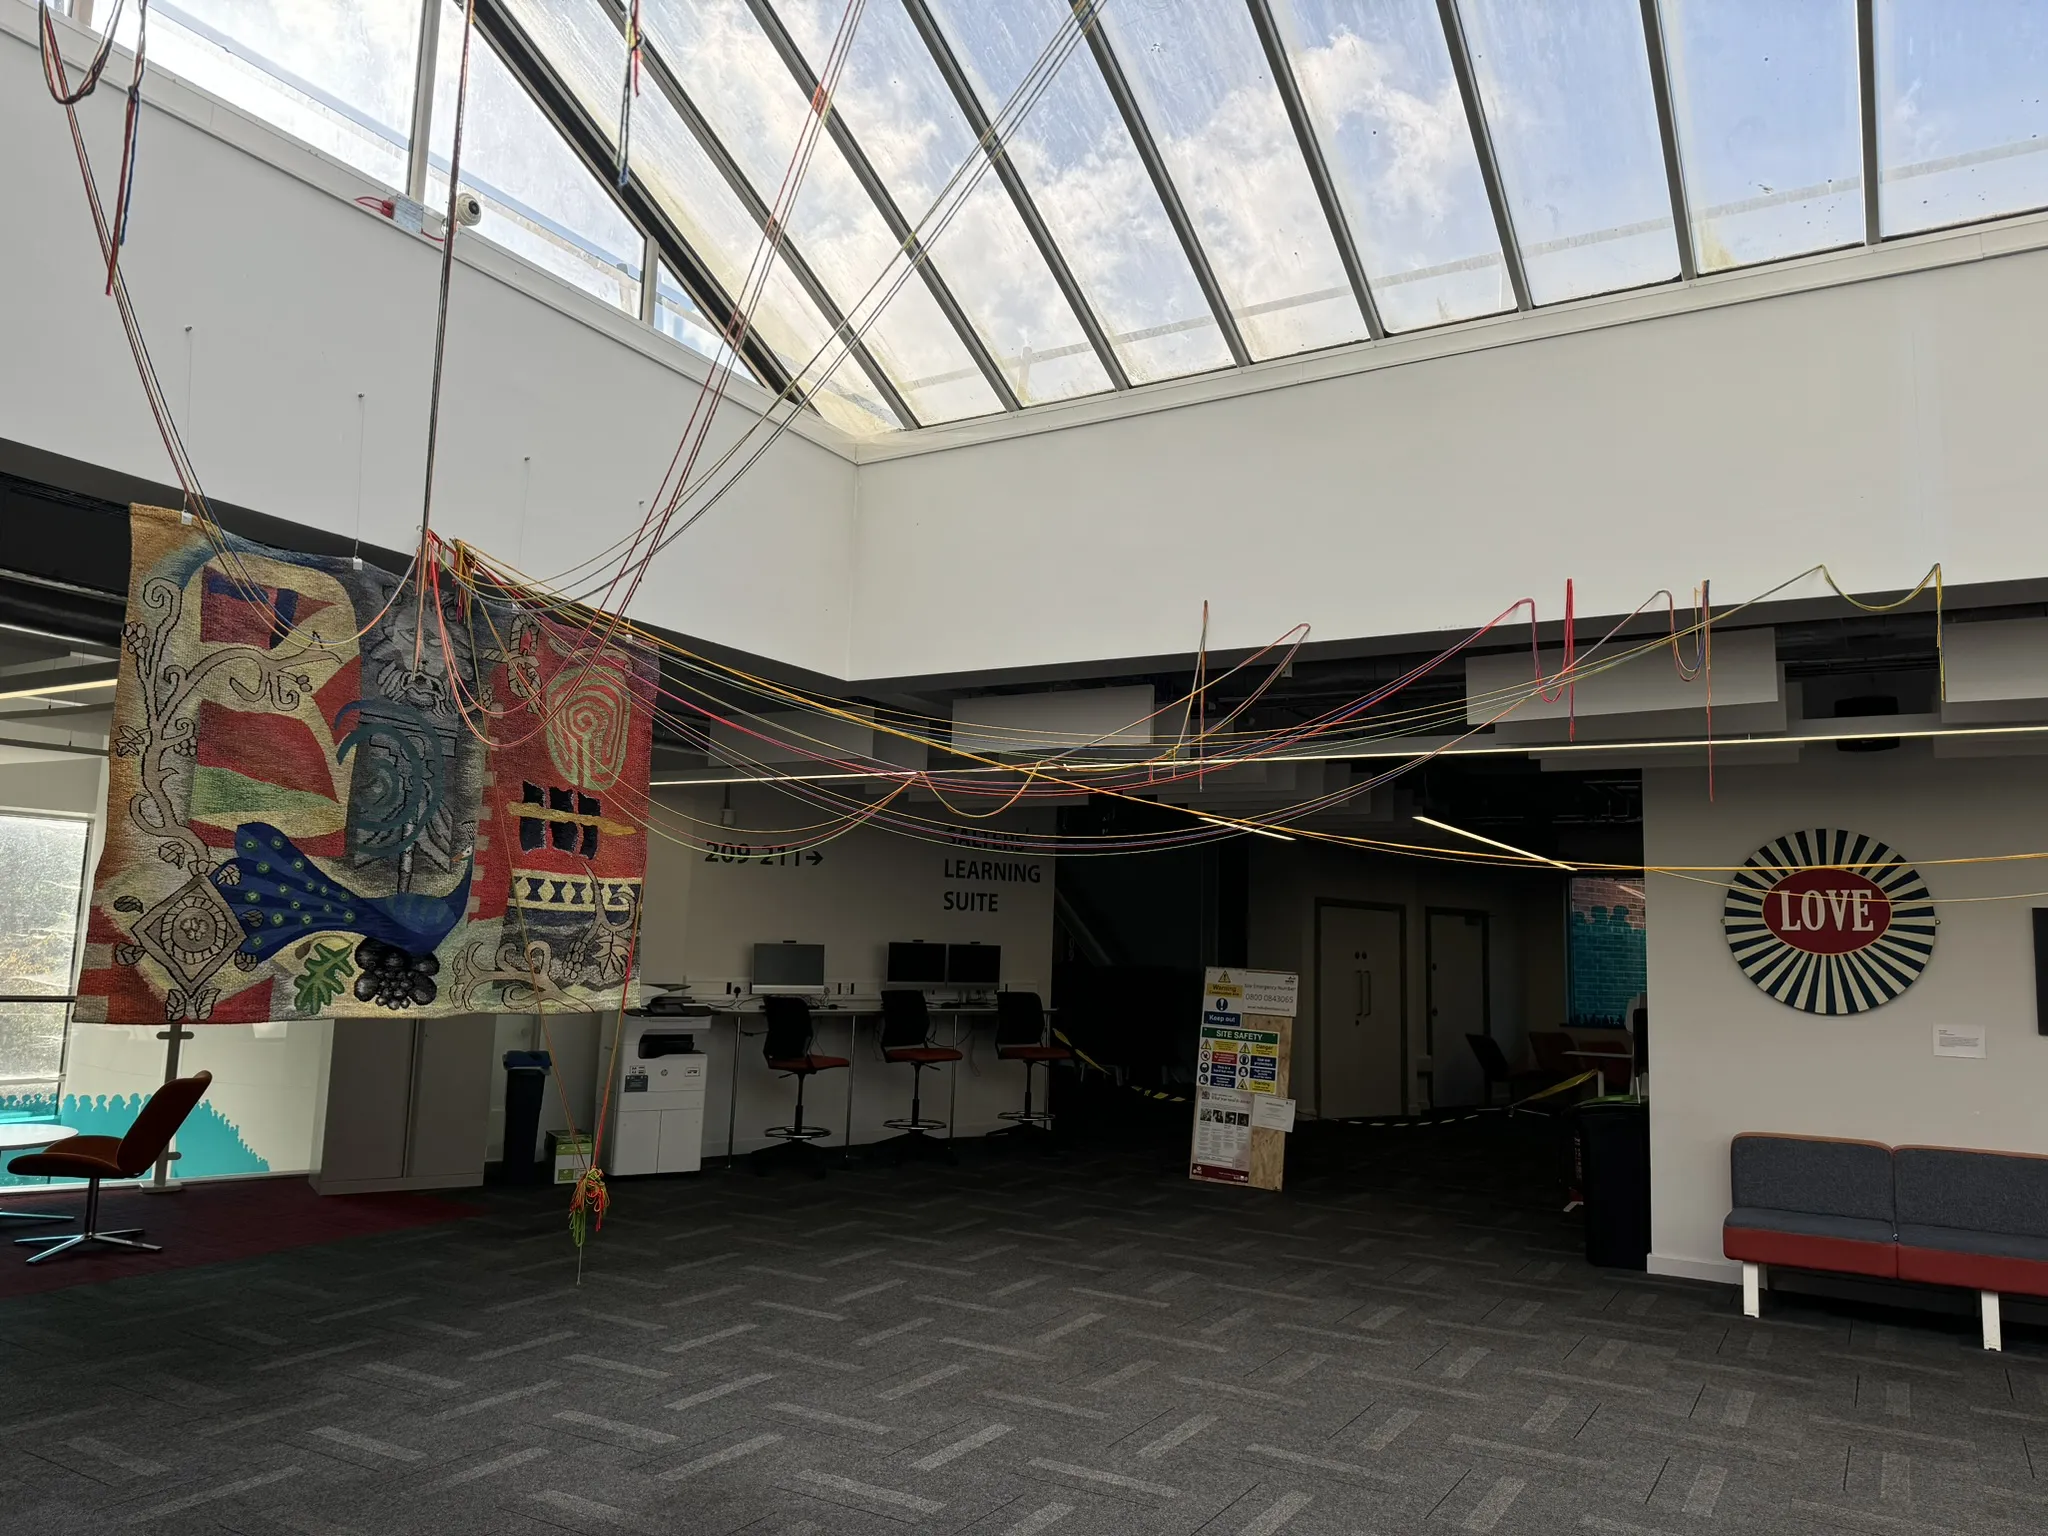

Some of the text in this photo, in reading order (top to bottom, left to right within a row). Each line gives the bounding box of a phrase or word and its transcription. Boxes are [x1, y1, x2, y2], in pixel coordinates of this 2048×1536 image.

[944, 858, 1041, 883] LEARNING
[943, 891, 999, 912] SUITE
[1778, 889, 1874, 931] LOVE
[1212, 984, 1237, 993] Warning
[1216, 1030, 1263, 1040] SITE SAFETY
